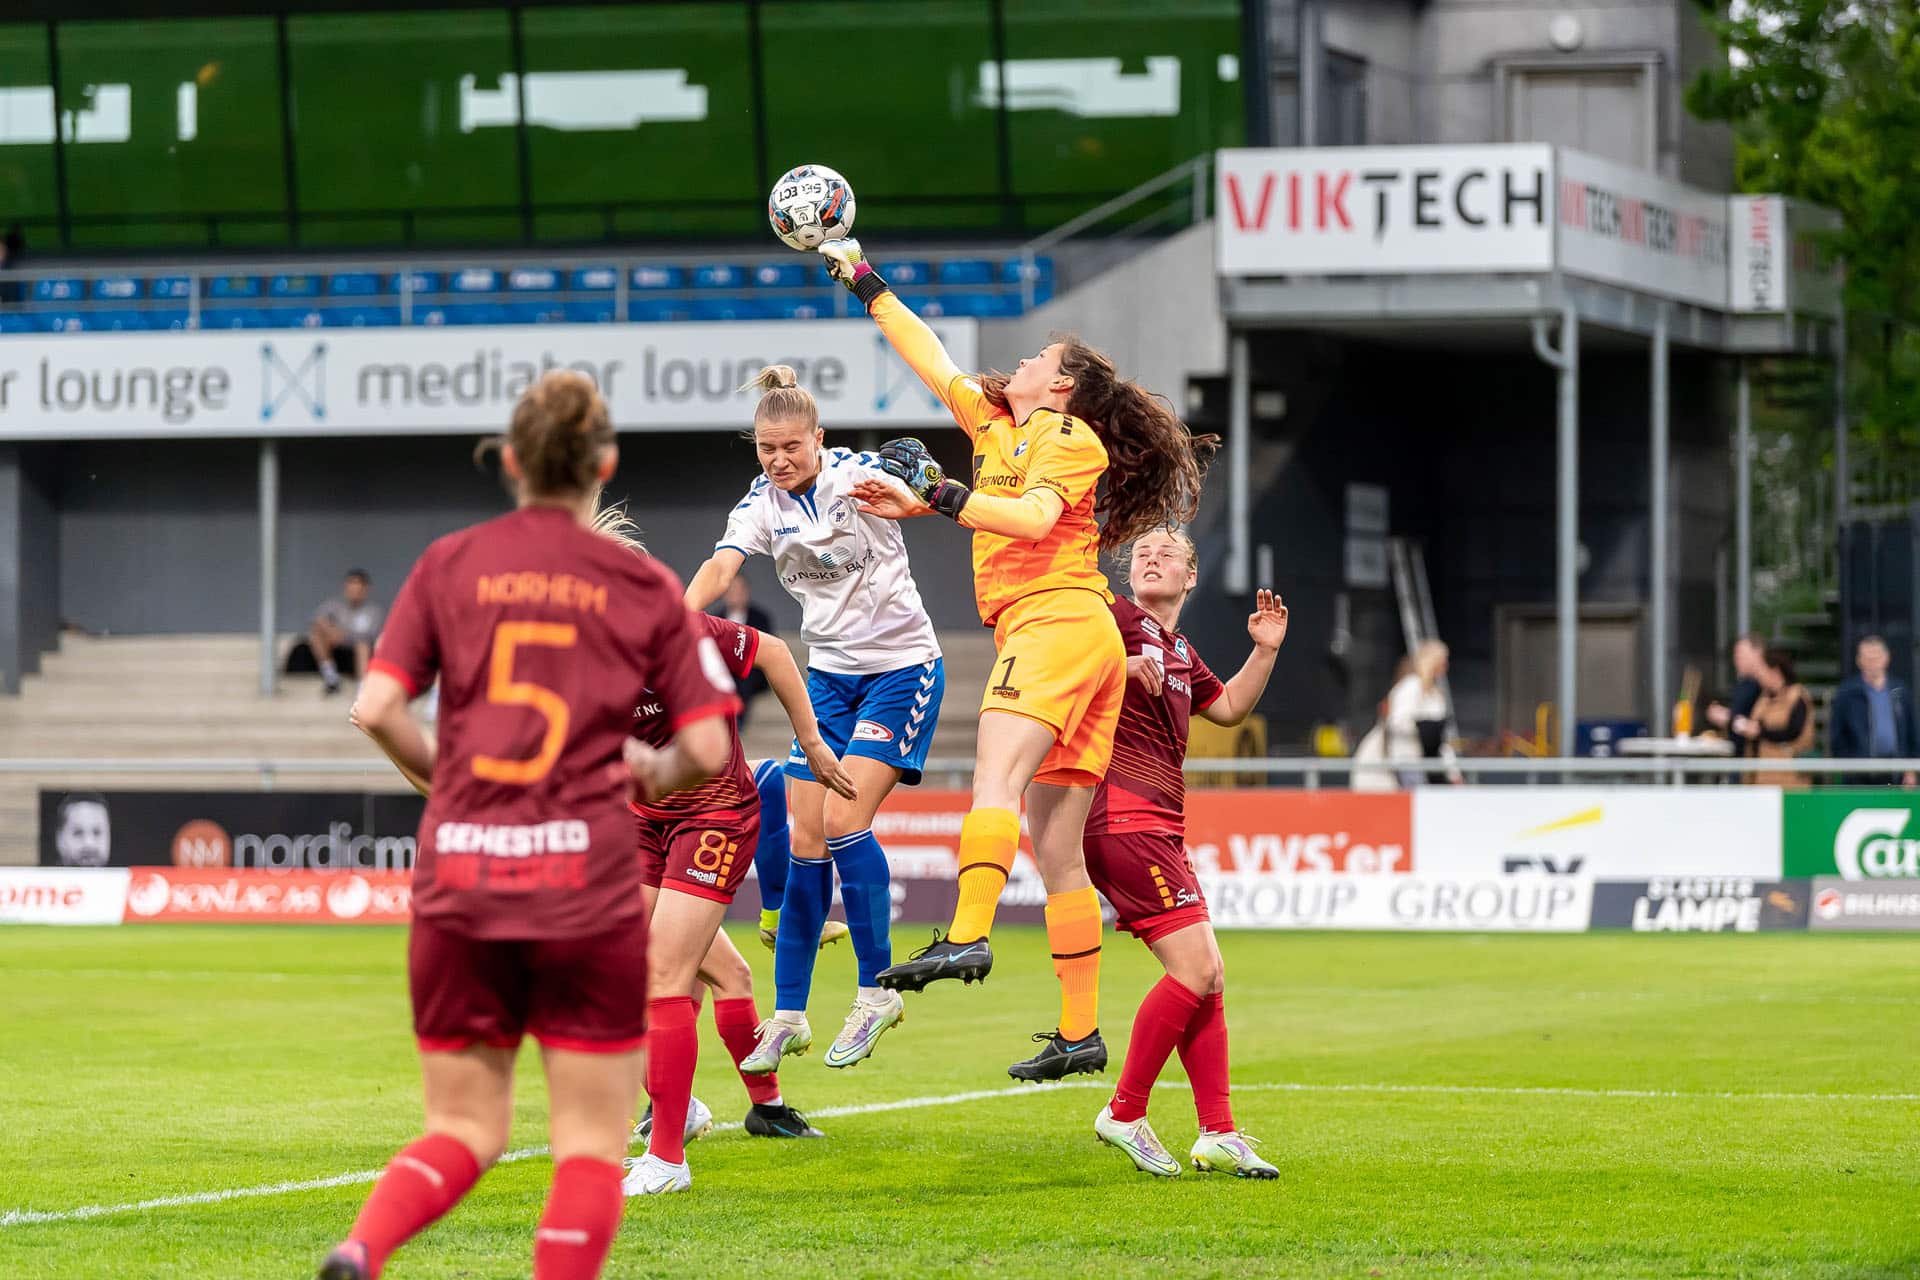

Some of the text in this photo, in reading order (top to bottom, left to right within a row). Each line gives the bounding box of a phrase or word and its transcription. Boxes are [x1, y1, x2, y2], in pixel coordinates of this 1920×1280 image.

[1222, 170, 1546, 243] VIKTECH
[39, 355, 231, 425] lounge
[642, 344, 847, 404] loune
[993, 656, 1016, 690] 1
[1167, 674, 1185, 692] spar
[471, 621, 577, 784] 5
[693, 830, 727, 871] 8
[1228, 833, 1403, 875] VVS'er
[686, 868, 717, 884] capelli
[1204, 880, 1358, 926] ROUP
[1389, 880, 1576, 926] GROUP
[1632, 897, 1762, 931] LAMPE
